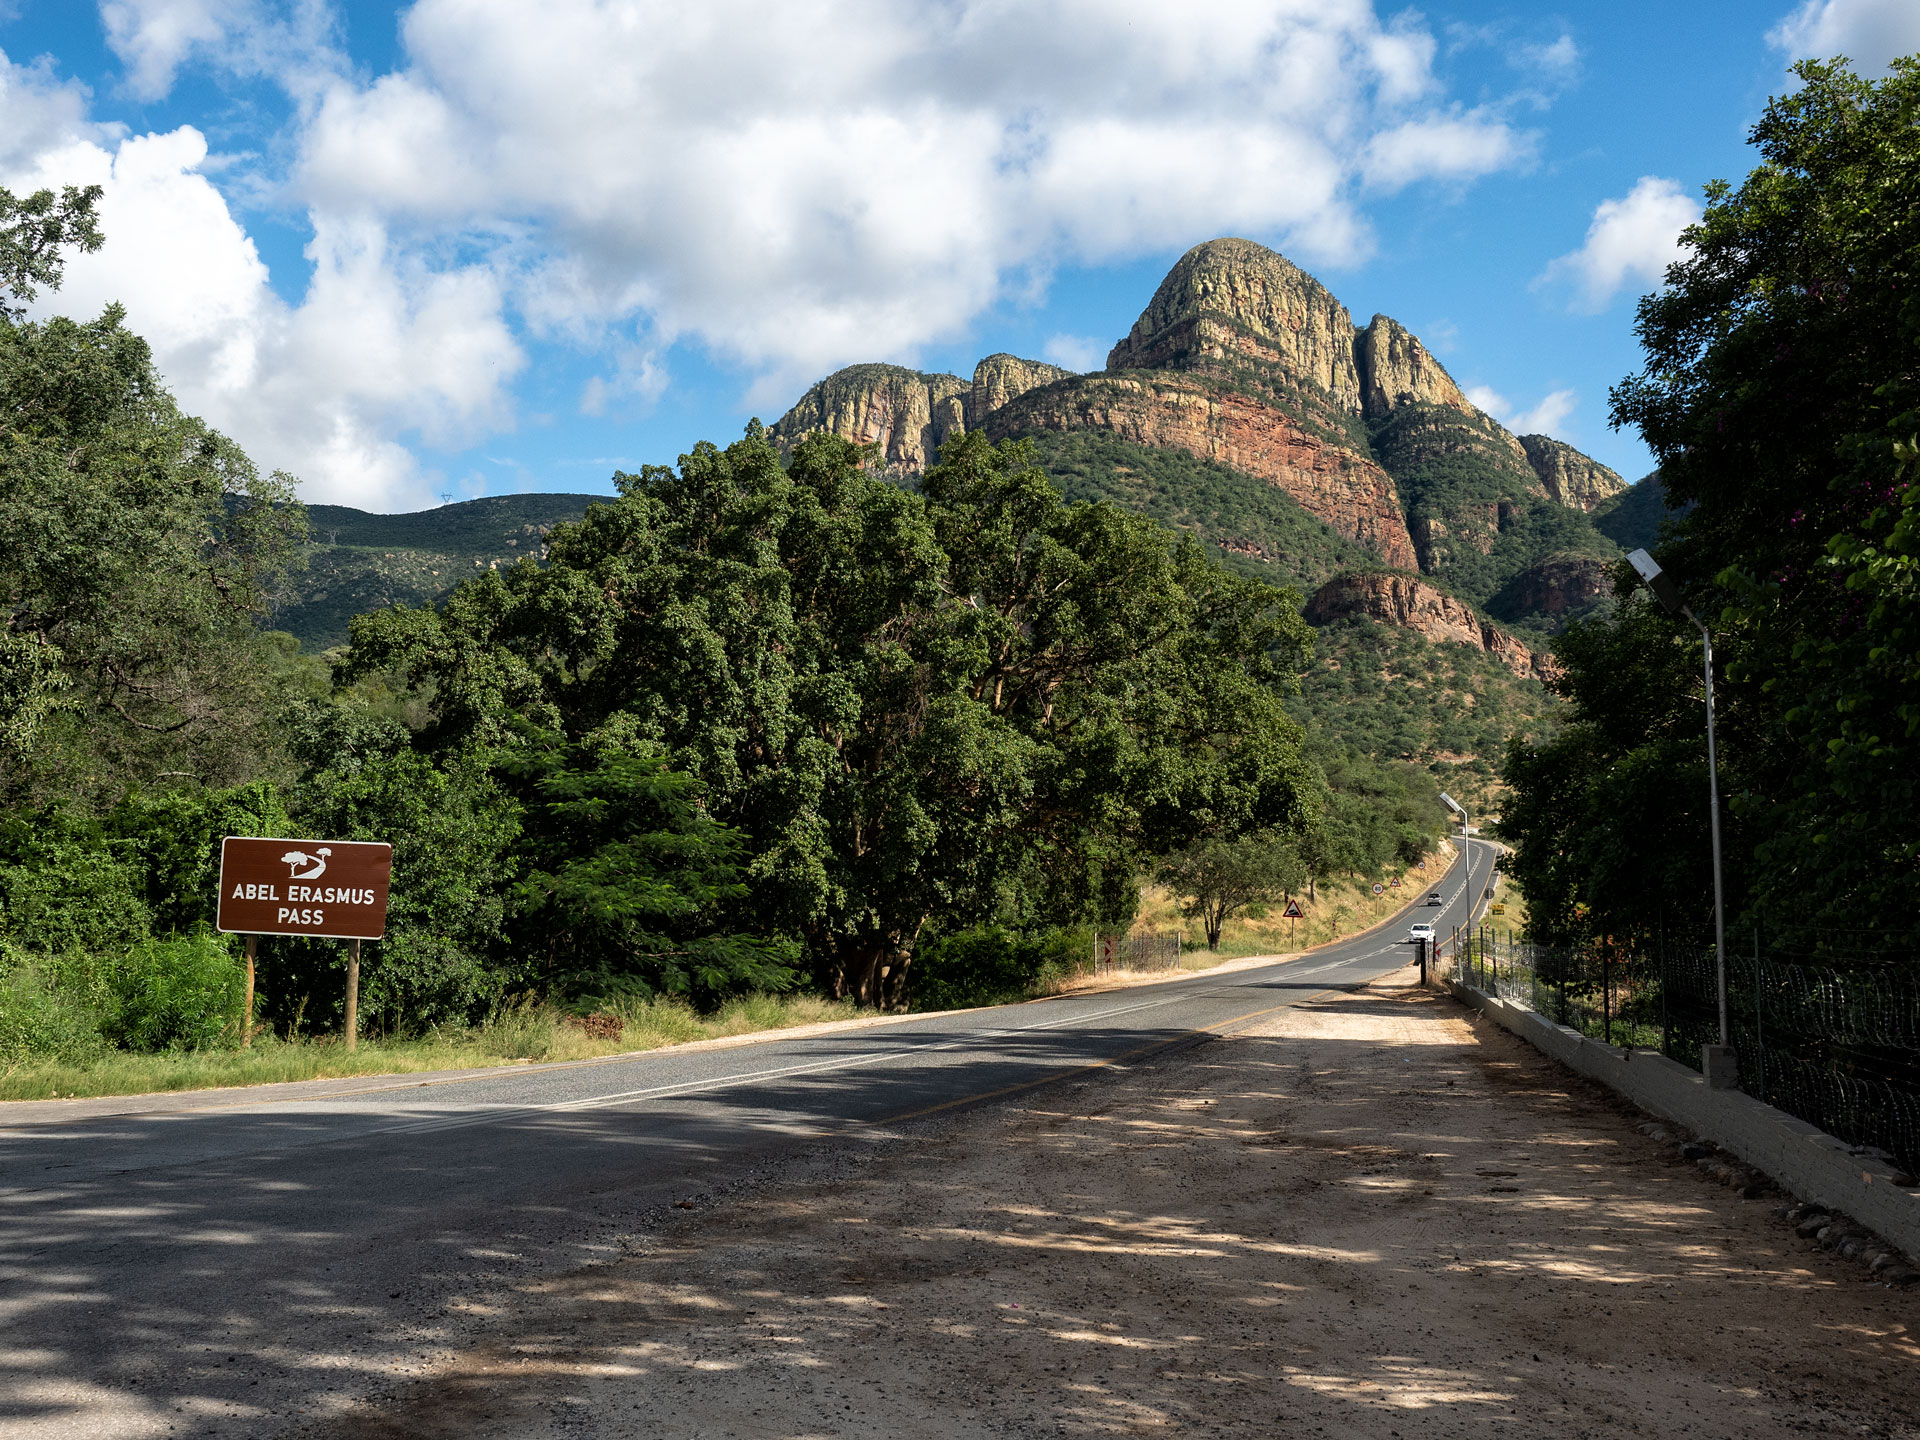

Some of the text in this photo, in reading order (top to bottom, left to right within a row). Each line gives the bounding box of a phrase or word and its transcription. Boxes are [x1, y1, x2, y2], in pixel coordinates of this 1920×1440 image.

[232, 883, 375, 905] ABEL ERASMUS
[277, 907, 324, 925] PASS
